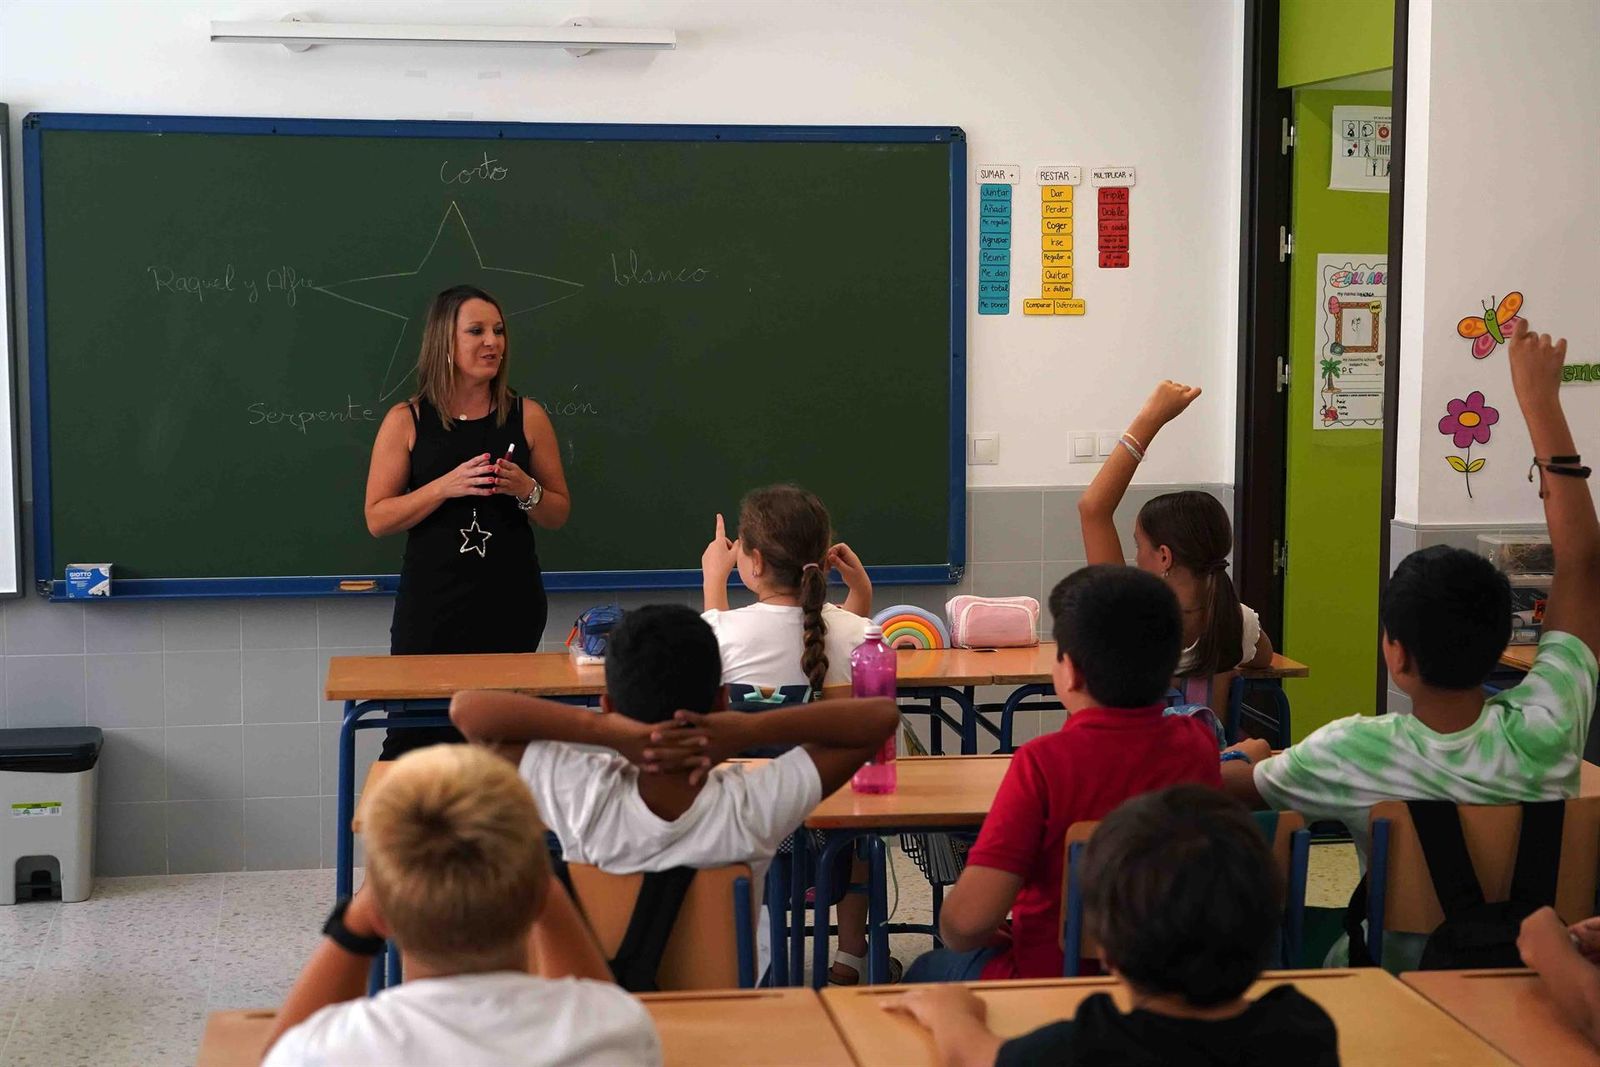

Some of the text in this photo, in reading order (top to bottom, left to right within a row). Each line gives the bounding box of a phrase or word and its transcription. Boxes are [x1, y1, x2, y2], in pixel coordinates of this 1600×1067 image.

[440, 151, 508, 184] Corto
[980, 169, 1006, 179] SUMAR
[1040, 171, 1070, 181] RESTAR
[982, 188, 1009, 197] Juntar
[1050, 188, 1064, 198] Dar
[1102, 190, 1125, 201] Triple
[983, 203, 1008, 213] Añadir
[1045, 205, 1069, 213] Perder
[1102, 206, 1125, 217] Doble
[1046, 221, 1067, 233] Coger
[982, 235, 1009, 247] Agrupar
[983, 252, 1007, 262] Reunir
[981, 268, 1008, 277] Me dan
[1045, 270, 1070, 280] Quitar
[148, 263, 236, 303] Raquel
[991, 284, 1009, 292] total
[1025, 301, 1052, 309] Comparar
